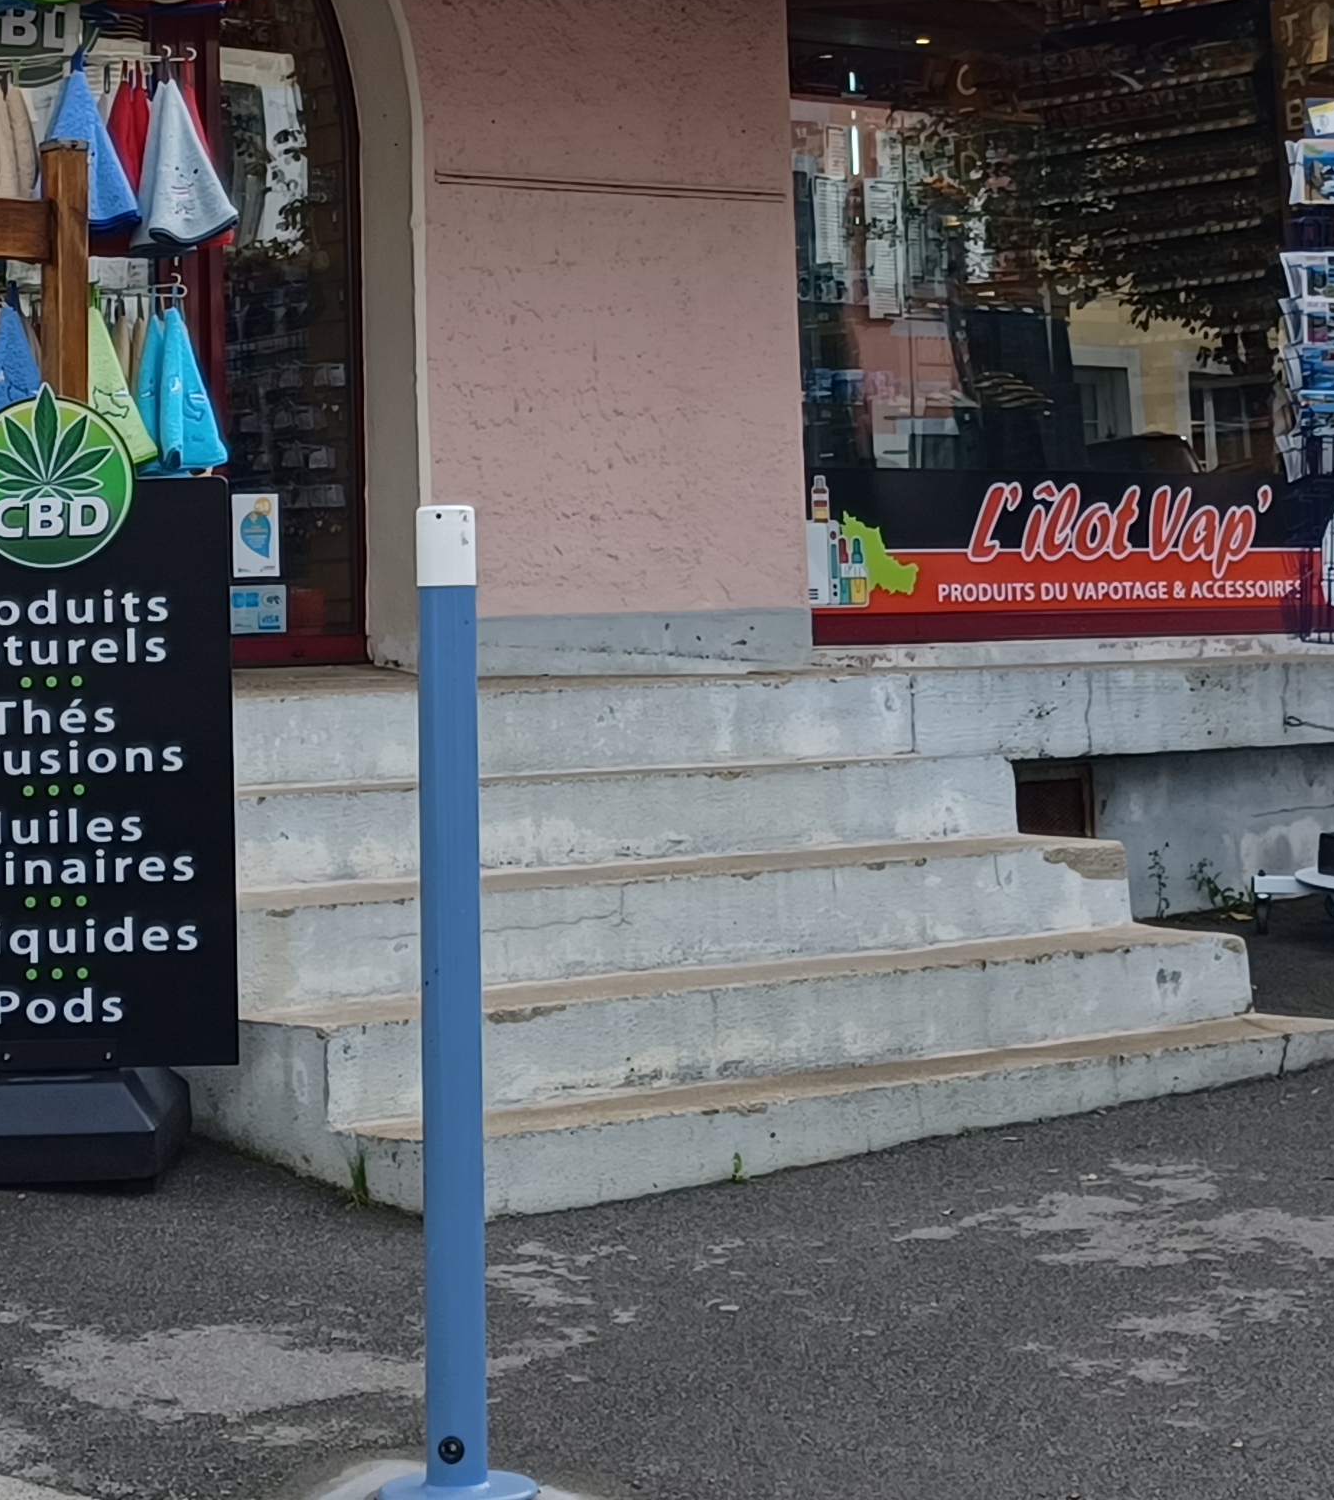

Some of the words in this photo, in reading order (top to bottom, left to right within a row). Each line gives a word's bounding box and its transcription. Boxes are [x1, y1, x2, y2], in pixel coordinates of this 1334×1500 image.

[967, 479, 1141, 563] L'îlot
[1148, 484, 1273, 580] Vap'
[937, 581, 1036, 603] PRODUITS
[1041, 581, 1068, 602] DU
[1071, 580, 1169, 601] VAPOTAGE
[1172, 580, 1187, 599] &
